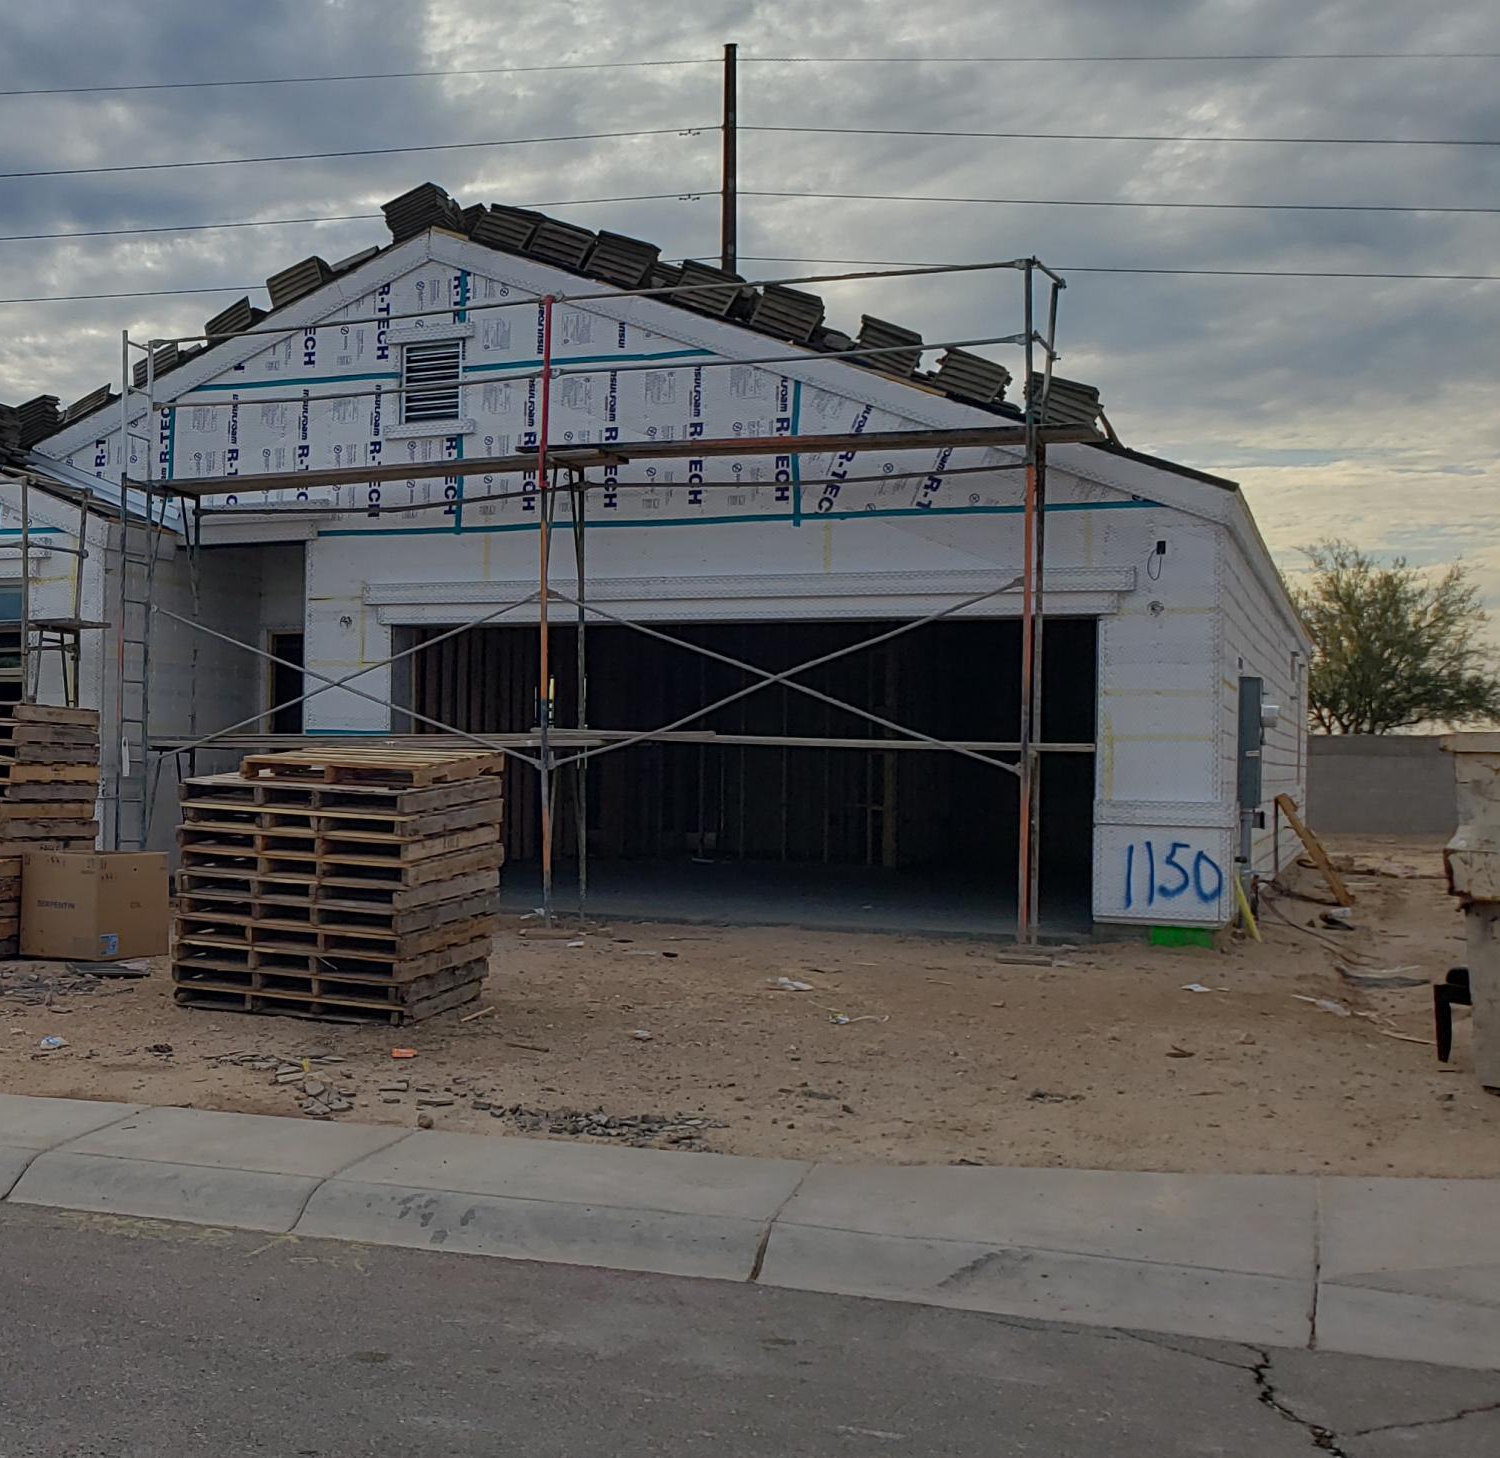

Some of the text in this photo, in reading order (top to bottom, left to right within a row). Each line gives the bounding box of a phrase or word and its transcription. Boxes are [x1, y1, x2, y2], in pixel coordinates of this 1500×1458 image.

[303, 327, 317, 367] ECH
[376, 283, 391, 361] R-TECH
[94, 439, 107, 467] R-T
[160, 407, 171, 463] R-TEC
[603, 427, 619, 508] RECH
[688, 422, 704, 505] RECH
[775, 417, 791, 502] RECH
[522, 432, 537, 511] RECH
[818, 451, 856, 513] R-TEC
[916, 475, 943, 509] R-T
[1124, 841, 1224, 909] 1150
